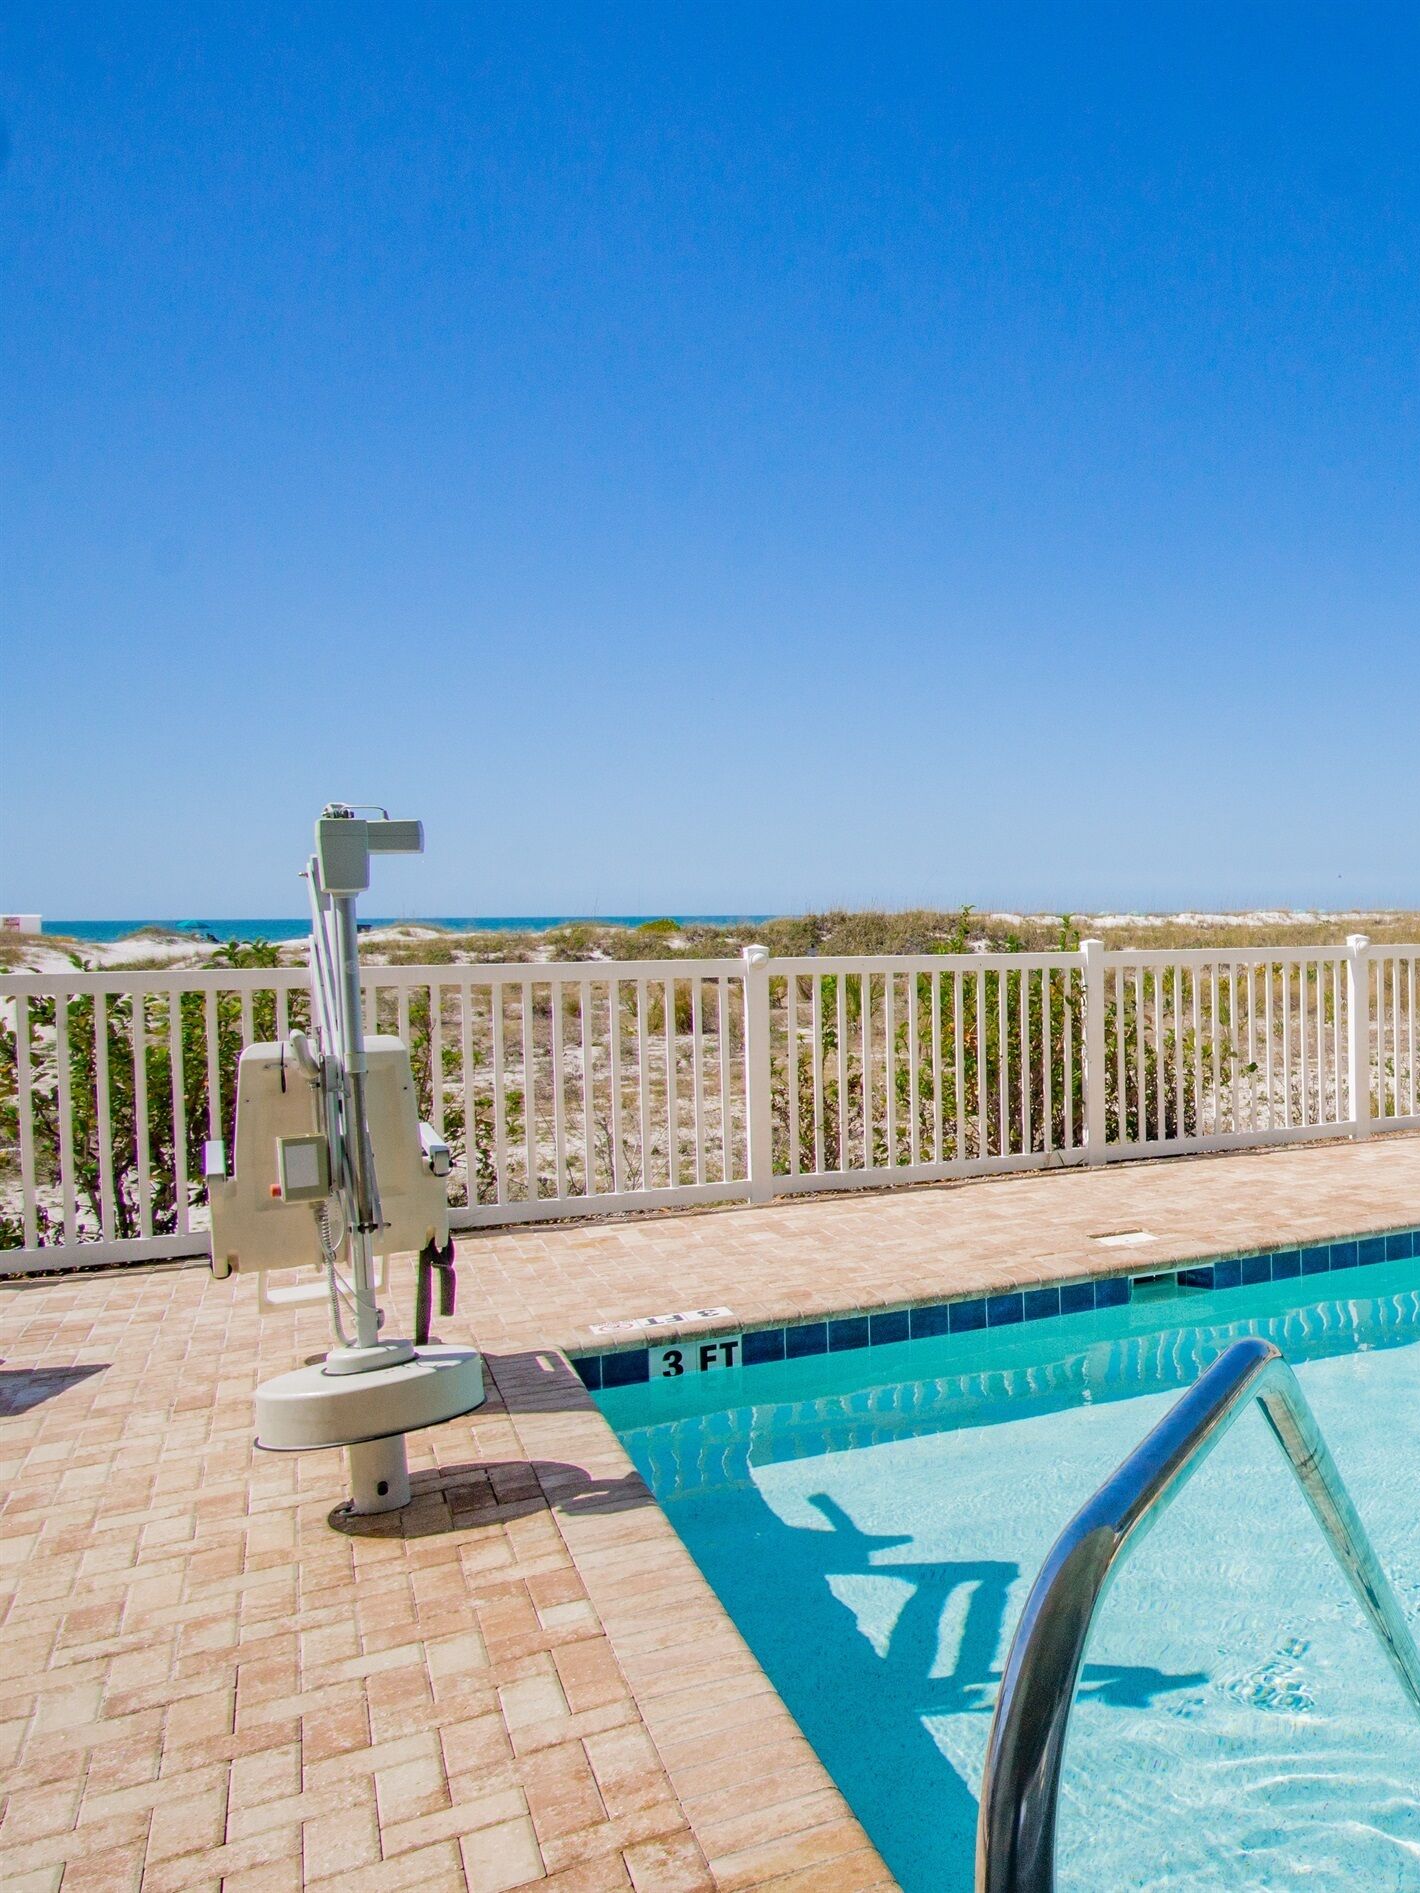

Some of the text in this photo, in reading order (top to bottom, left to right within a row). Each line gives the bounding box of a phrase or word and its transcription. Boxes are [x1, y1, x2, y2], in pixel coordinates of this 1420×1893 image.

[697, 1308, 721, 1318] 3
[644, 1314, 685, 1327] FT
[662, 1340, 739, 1378] 3 FT
